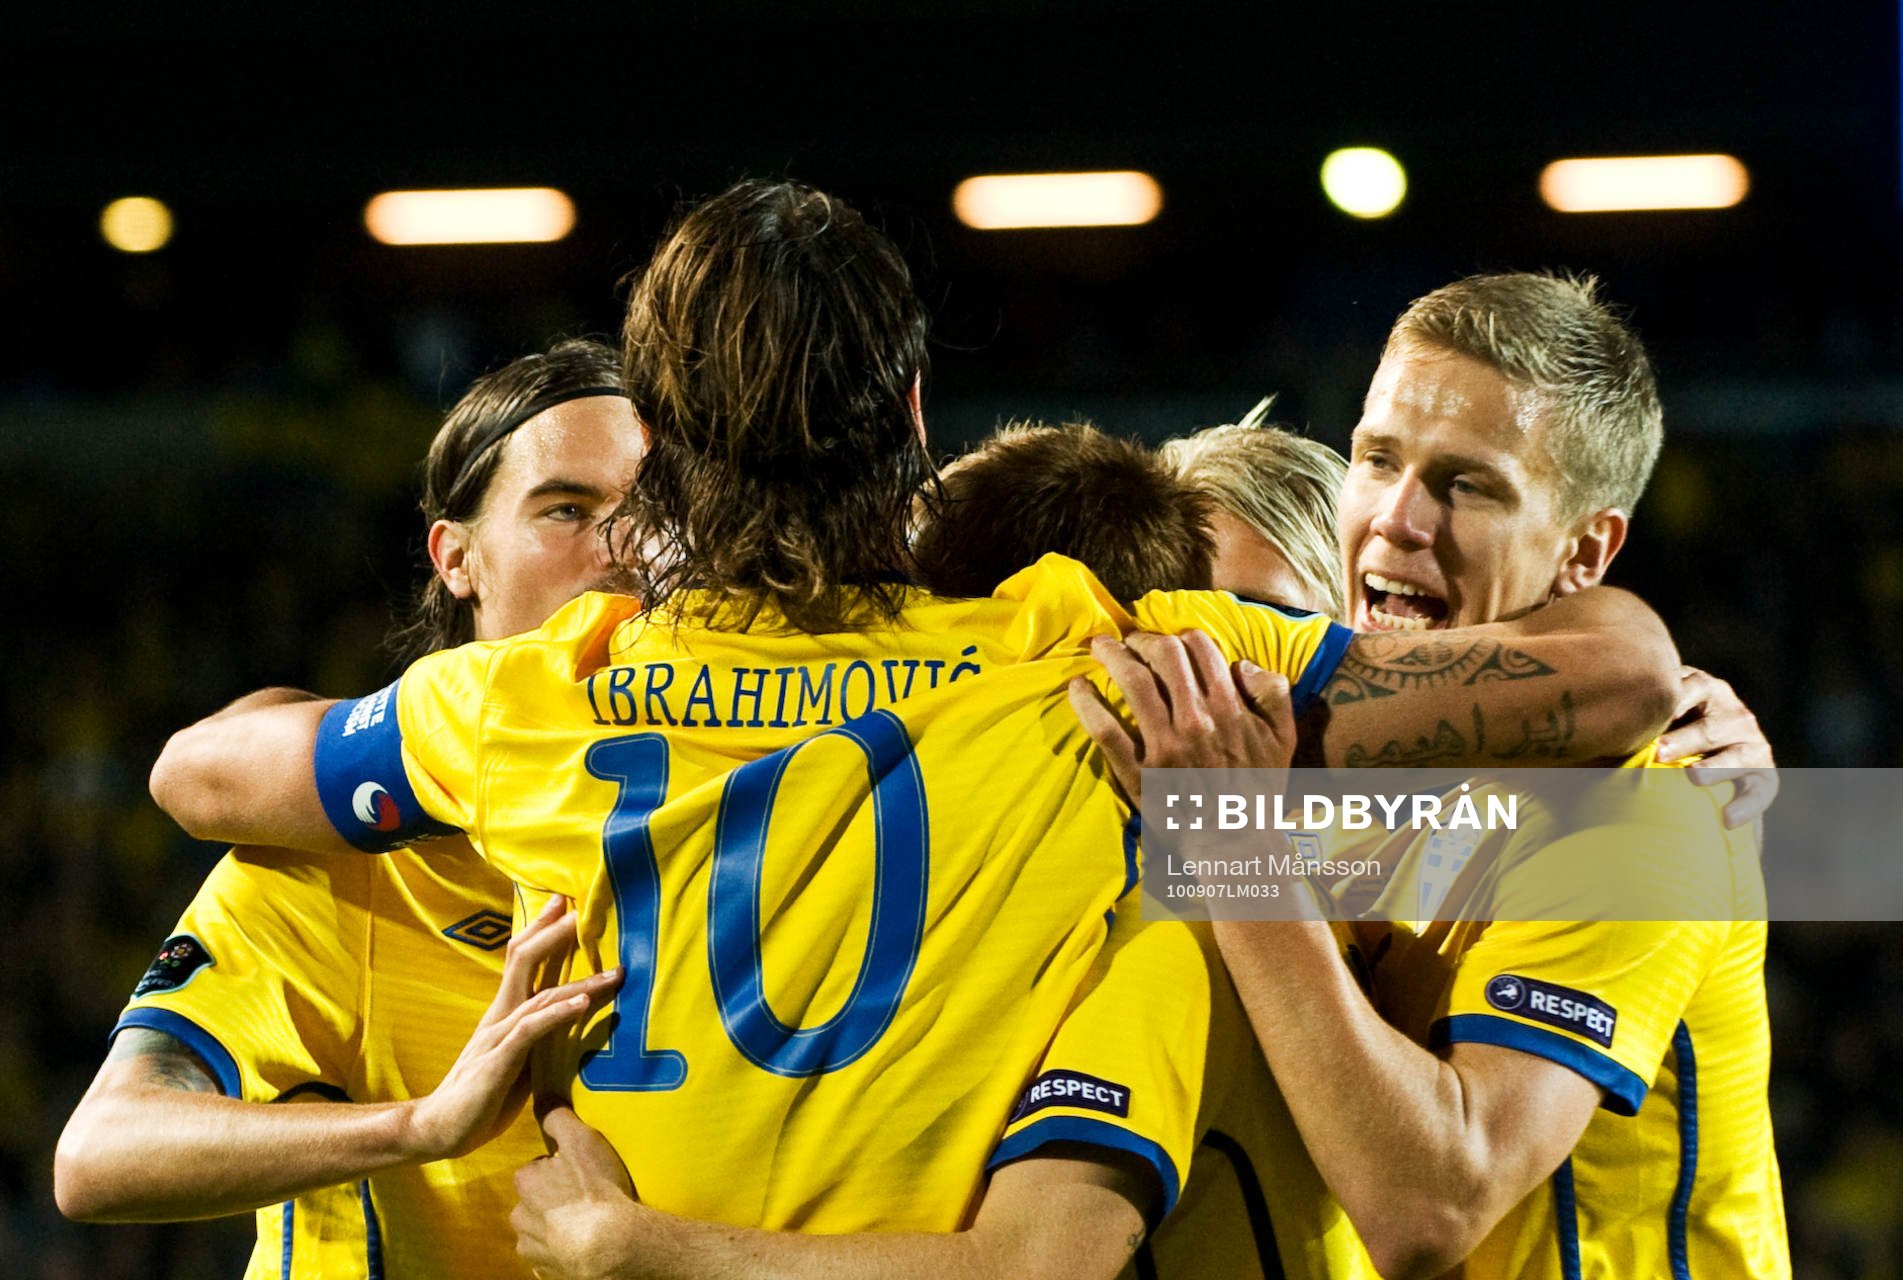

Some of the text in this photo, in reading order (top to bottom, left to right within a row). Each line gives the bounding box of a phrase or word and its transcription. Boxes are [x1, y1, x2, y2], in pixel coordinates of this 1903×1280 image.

[577, 708, 931, 1092] 10
[1529, 989, 1615, 1038] RESPECT
[1029, 1078, 1124, 1107] RESPECT
